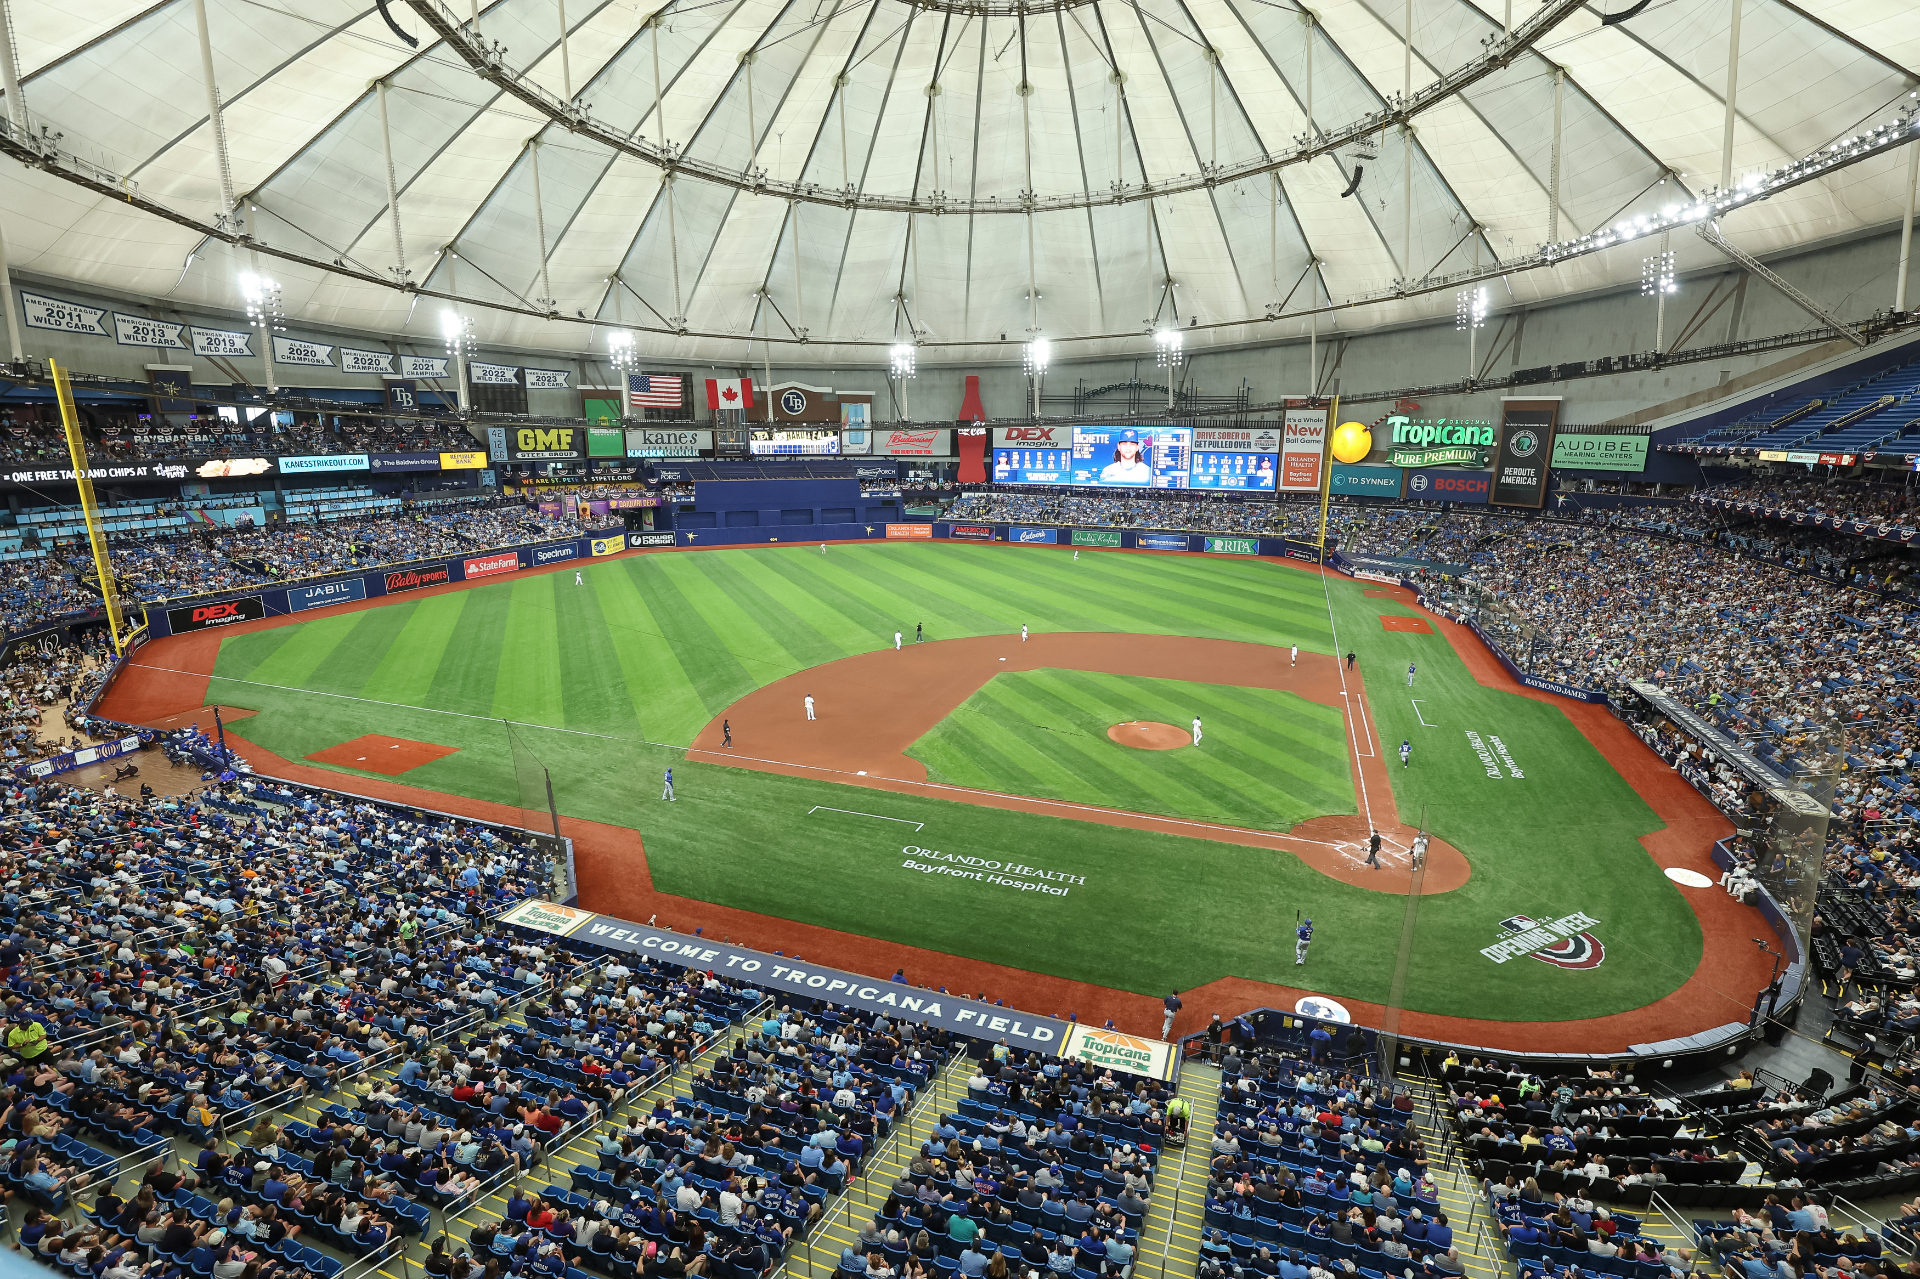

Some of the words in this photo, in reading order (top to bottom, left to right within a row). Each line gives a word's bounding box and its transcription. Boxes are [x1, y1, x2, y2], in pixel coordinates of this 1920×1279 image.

[26, 298, 66, 310] AMERICAN
[70, 306, 98, 316] LEAGUE
[46, 308, 82, 322] 2011
[34, 316, 62, 326] WILD
[66, 322, 96, 332] CARD
[116, 318, 151, 326] AMERICAN
[132, 326, 165, 338] 2013
[124, 334, 148, 342] WILD
[151, 338, 176, 346] CARD
[206, 337, 235, 347] 2019
[288, 347, 316, 357] 2020
[281, 354, 326, 364] CHAMPIONS
[353, 357, 380, 366] 2020
[786, 394, 802, 410] TB
[1005, 428, 1056, 440] DEX
[1286, 424, 1323, 436] New
[1387, 416, 1494, 447] Tropicana
[517, 428, 573, 450] GMF
[642, 431, 697, 445] kane's
[892, 434, 933, 446] Budweiser
[1074, 434, 1109, 444] BICHETTE
[1234, 441, 1251, 449] OVER
[1556, 441, 1646, 452] AUDIBEL
[493, 450, 504, 459] 66
[1394, 451, 1422, 464] PURE
[1424, 450, 1477, 463] PREMIUM
[285, 459, 364, 469] KANESSTRIKEOUT.COM
[12, 472, 33, 482] ONE
[34, 470, 58, 480] FREE
[87, 469, 108, 478] AND
[109, 468, 135, 477] CHIPS
[136, 467, 147, 476] AT
[1504, 467, 1536, 477] REROUTE
[1360, 477, 1395, 486] SYNNEX
[1434, 478, 1488, 492] BOSCH
[1501, 476, 1537, 486] AMERICAS
[1224, 540, 1251, 553] RIPA
[538, 548, 571, 561] Spectrum
[479, 561, 498, 572] State
[498, 558, 516, 569] Farm
[388, 573, 422, 590] Bally
[422, 570, 447, 582] SPORTS
[305, 583, 349, 598] JABIL
[192, 602, 239, 622] DEX
[205, 612, 245, 625] imaging
[38, 634, 59, 652] 162
[1525, 677, 1562, 693] RAYMOND
[1562, 687, 1587, 699] JAMES
[1465, 730, 1487, 751] HEALTH
[32, 765, 49, 774] Rays
[1476, 750, 1503, 779] ORLANDO
[902, 846, 1001, 869] ORLANDO
[1003, 862, 1087, 886] HEALTH
[902, 859, 984, 881] Bayfront
[986, 874, 1069, 896] Hospital
[525, 906, 572, 926] Tropicana
[1538, 916, 1553, 924] 24
[1480, 927, 1560, 964] OPENING
[1543, 911, 1601, 937] WEEK
[1496, 931, 1513, 939] 20
[589, 922, 720, 963] WELCOME
[726, 955, 762, 971] TO
[770, 964, 943, 1017] TROPICANA
[952, 1008, 1056, 1042] FIELD
[1082, 1035, 1152, 1063] Tropicana
[1092, 1055, 1138, 1067] FIELD
[1246, 1098, 1256, 1107] 23
[1560, 1095, 1571, 1104] 56
[765, 1200, 781, 1208] 27
[1096, 1218, 1111, 1228] DAD
